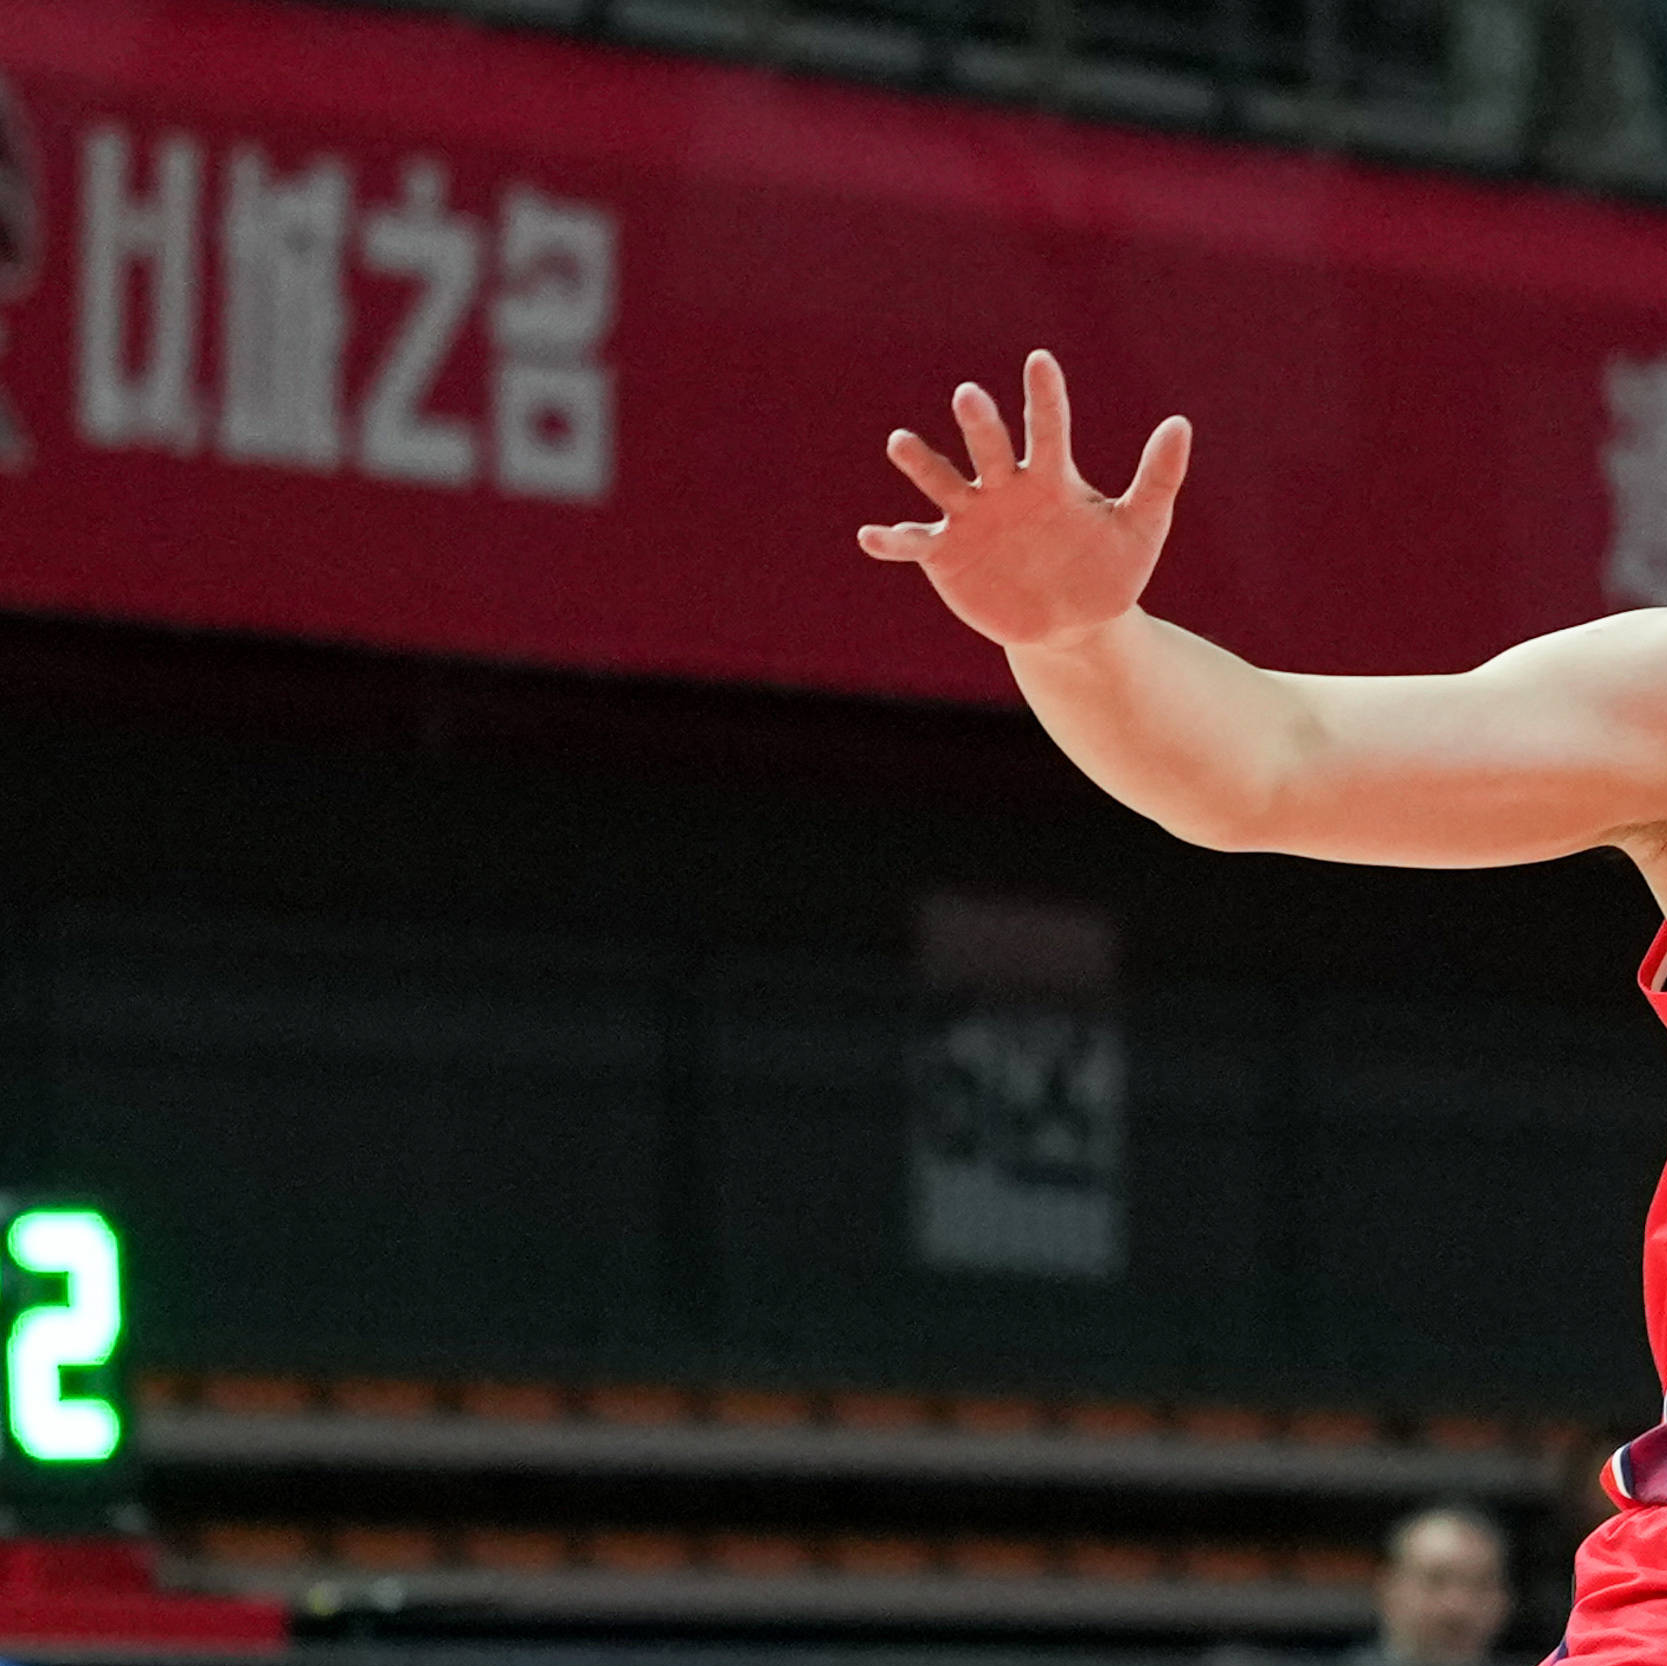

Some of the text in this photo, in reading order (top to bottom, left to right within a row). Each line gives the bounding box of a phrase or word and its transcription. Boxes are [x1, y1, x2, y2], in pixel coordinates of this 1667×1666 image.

[76, 122, 618, 508] 以城之名
[7, 1210, 123, 1462] 2
